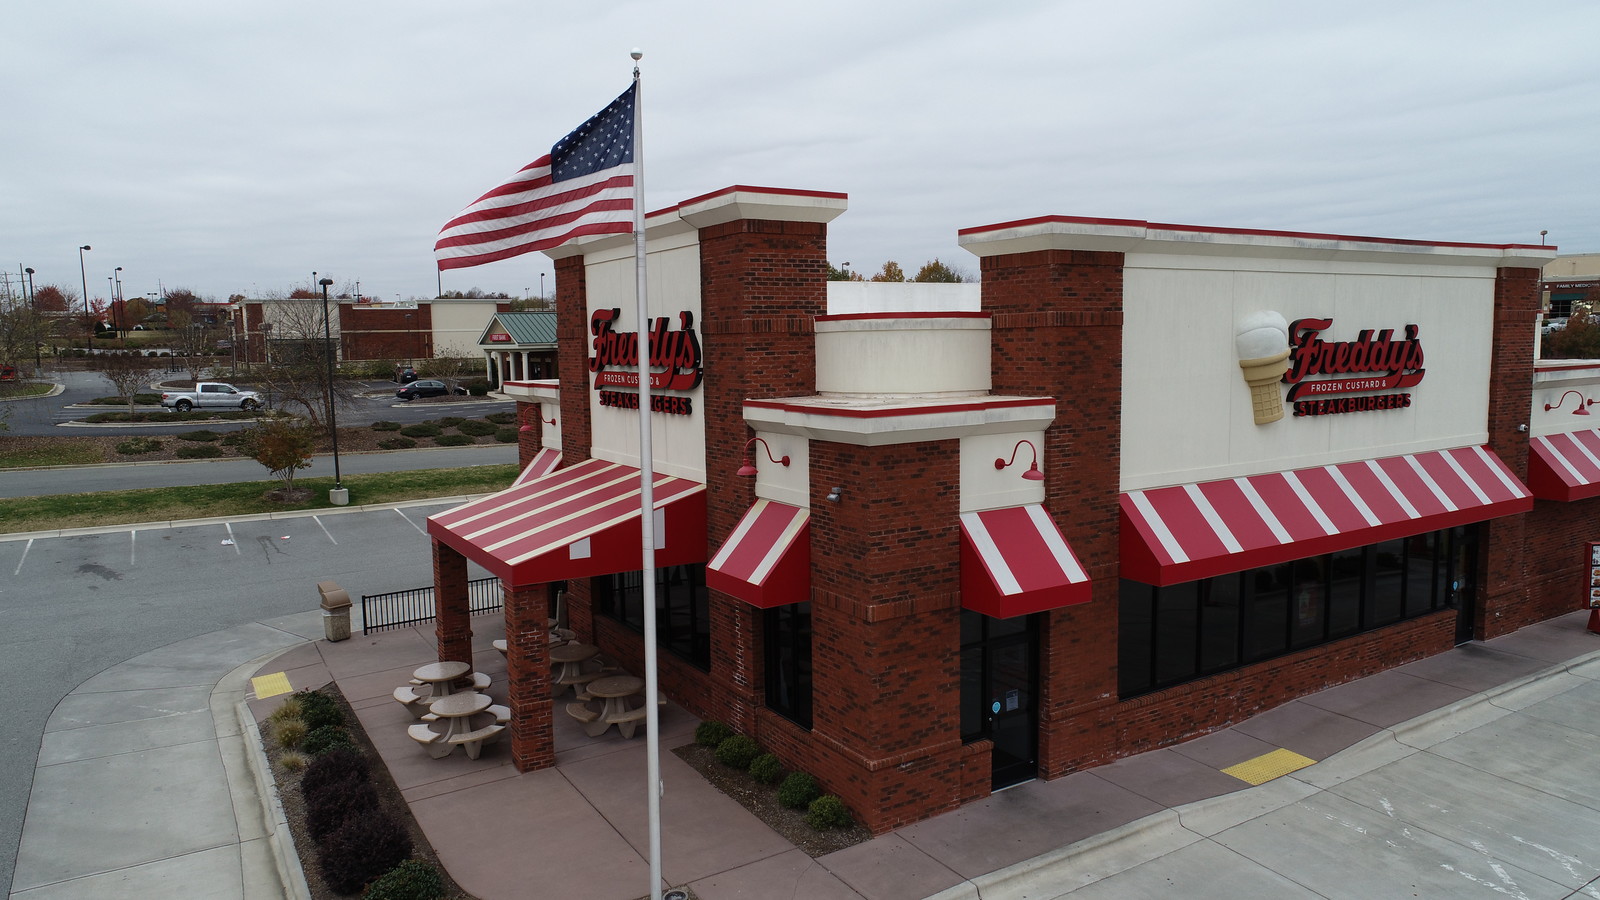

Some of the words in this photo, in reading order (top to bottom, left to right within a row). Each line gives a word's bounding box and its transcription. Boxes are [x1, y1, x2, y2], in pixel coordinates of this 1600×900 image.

[1281, 318, 1425, 384] Freddy's
[604, 374, 625, 383] FROZEN
[627, 375, 654, 385] CUSD
[656, 376, 660, 386] &
[1311, 382, 1343, 393] FROZEN
[1345, 380, 1381, 391] CUSTARD
[1382, 380, 1387, 388] &
[599, 391, 692, 415] STEAKBGERS
[1295, 393, 1412, 417] STEAKBURGERS
